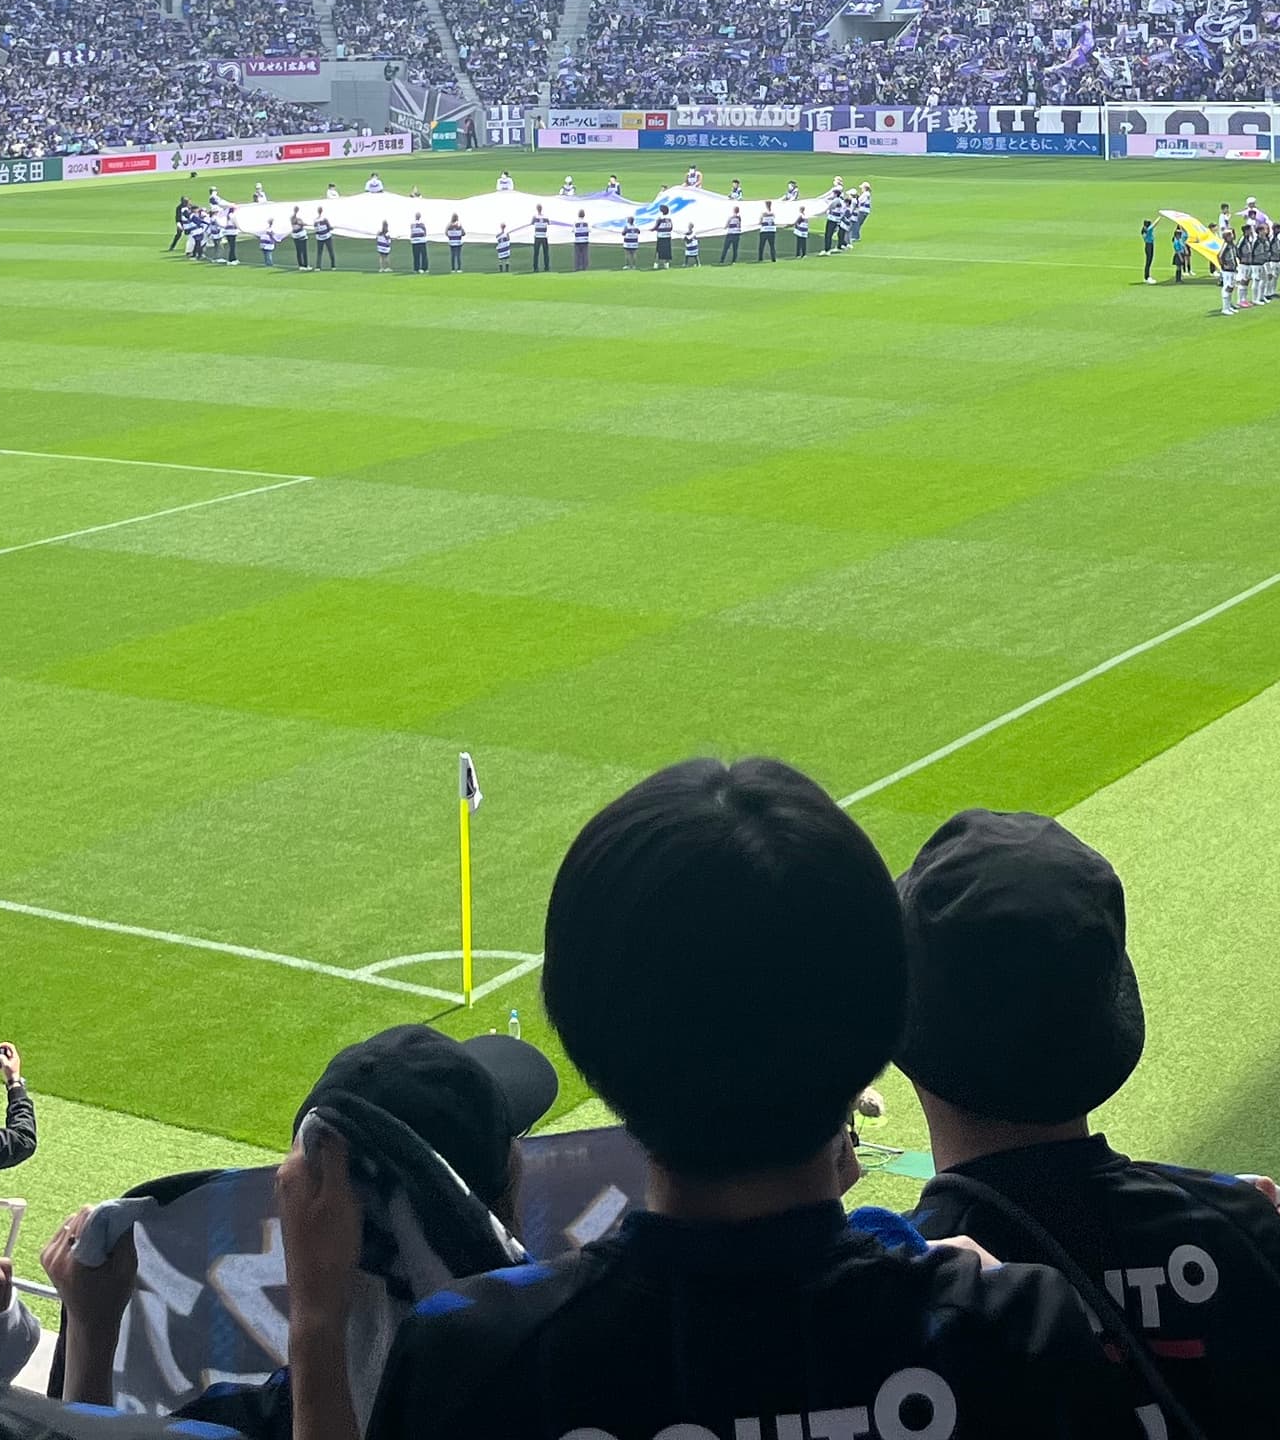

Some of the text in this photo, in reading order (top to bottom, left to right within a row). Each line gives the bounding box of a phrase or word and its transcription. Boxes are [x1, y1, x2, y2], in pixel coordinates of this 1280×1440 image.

[561, 132, 587, 144] MOL
[664, 133, 788, 148] 海の惑星とともに、次へ。
[838, 135, 867, 147] MOL
[955, 136, 1098, 152] 海の惑星とともに、次へ。
